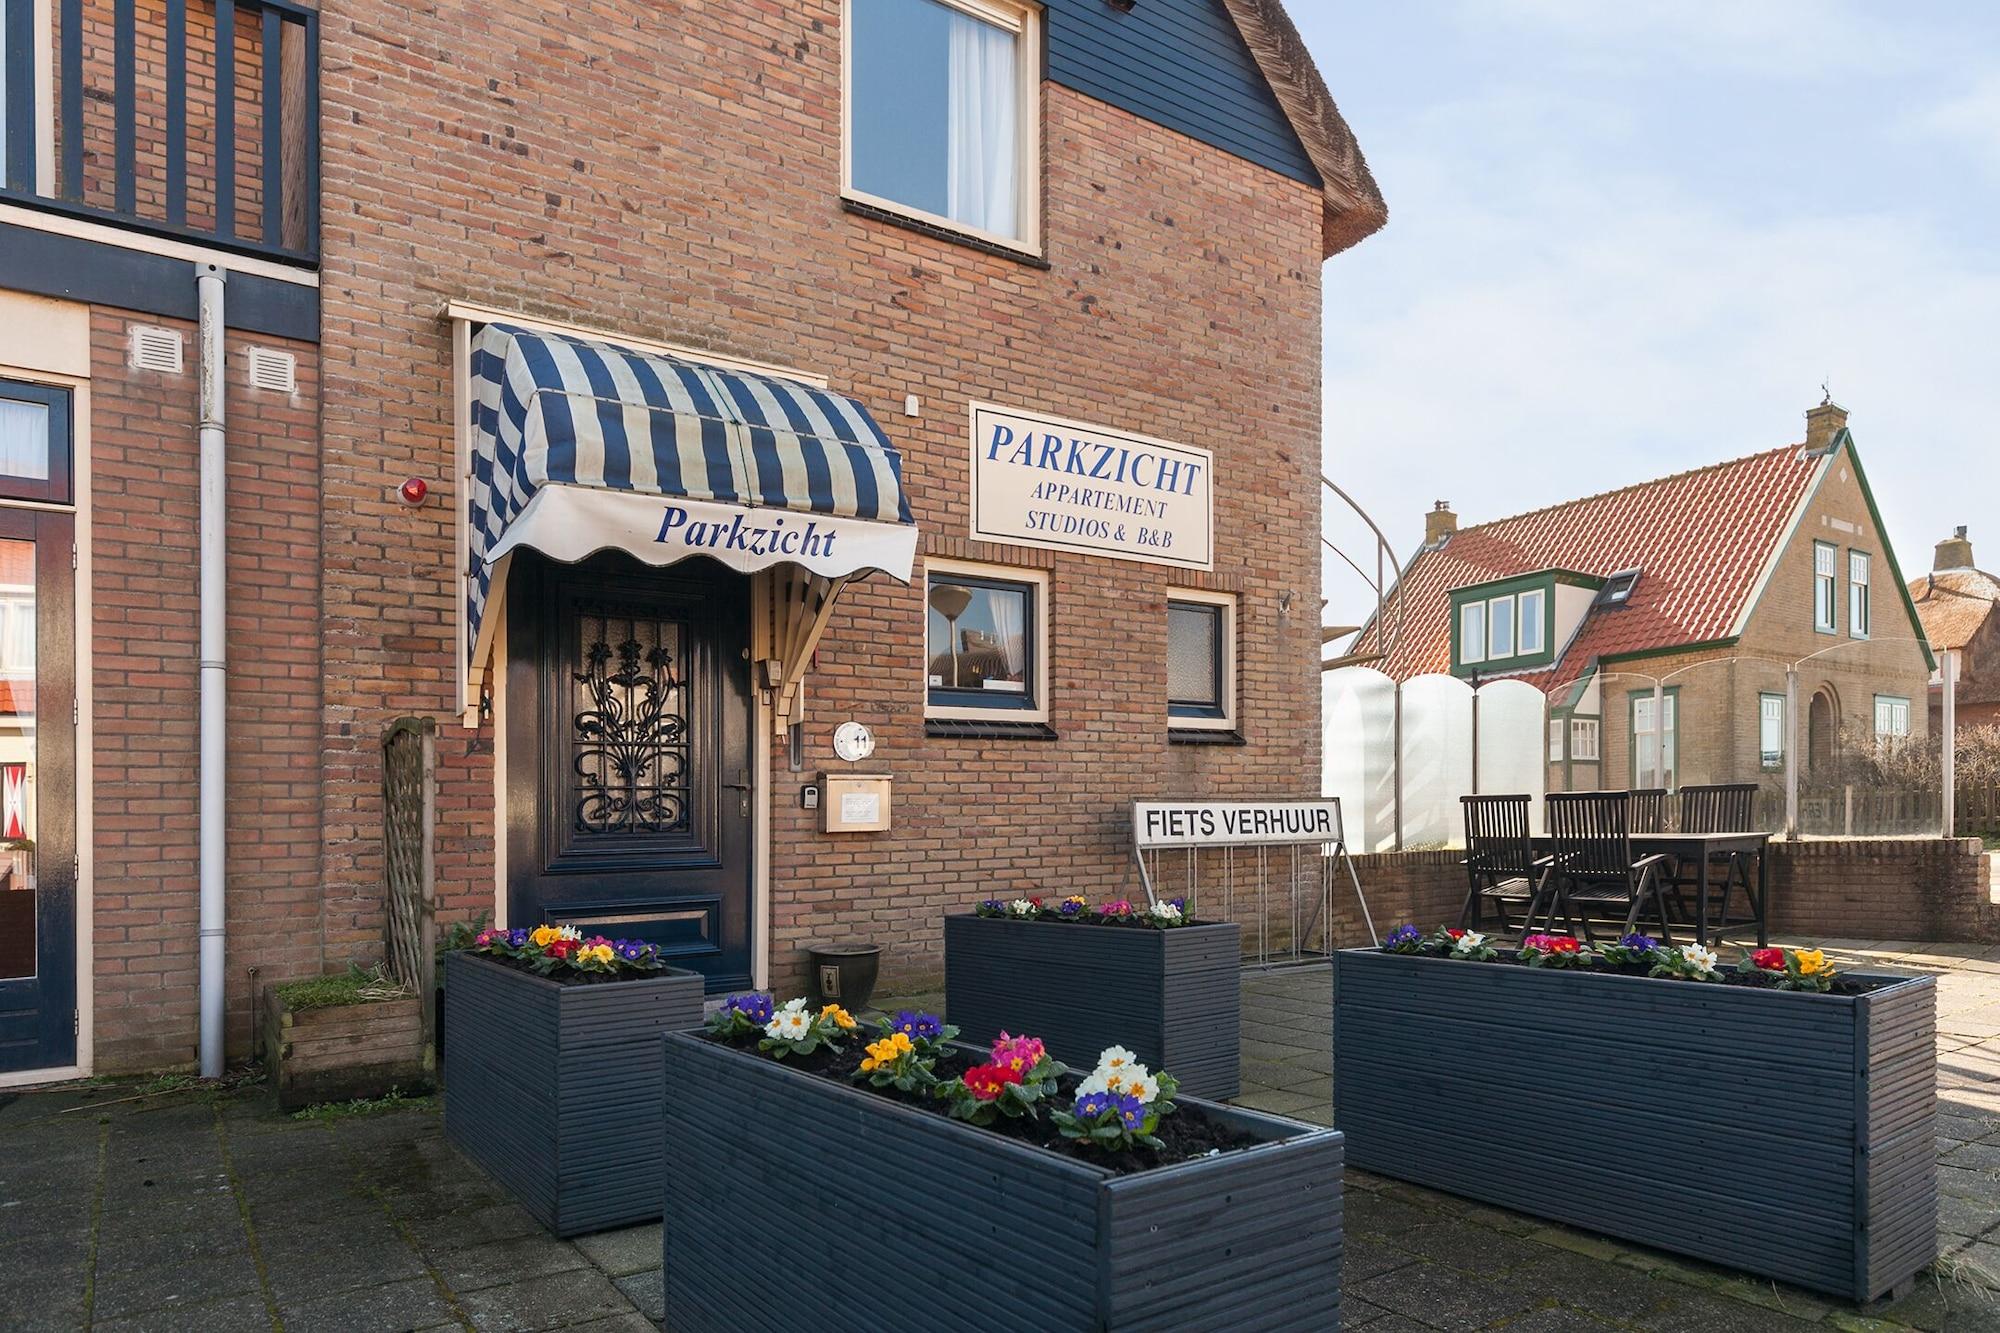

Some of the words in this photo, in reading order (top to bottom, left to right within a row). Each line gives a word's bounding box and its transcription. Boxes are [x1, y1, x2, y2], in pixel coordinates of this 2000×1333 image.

[986, 424, 1202, 497] PARKZICHT
[1030, 481, 1168, 520] APPARTEMENT
[653, 506, 837, 557] Parkzicht
[1025, 510, 1110, 539] STUDIOS
[1113, 524, 1126, 542] &
[1137, 527, 1173, 549] B&B
[854, 735, 867, 749] 11
[1146, 809, 1216, 837] FIETS
[1222, 808, 1332, 835] VERHUUR
